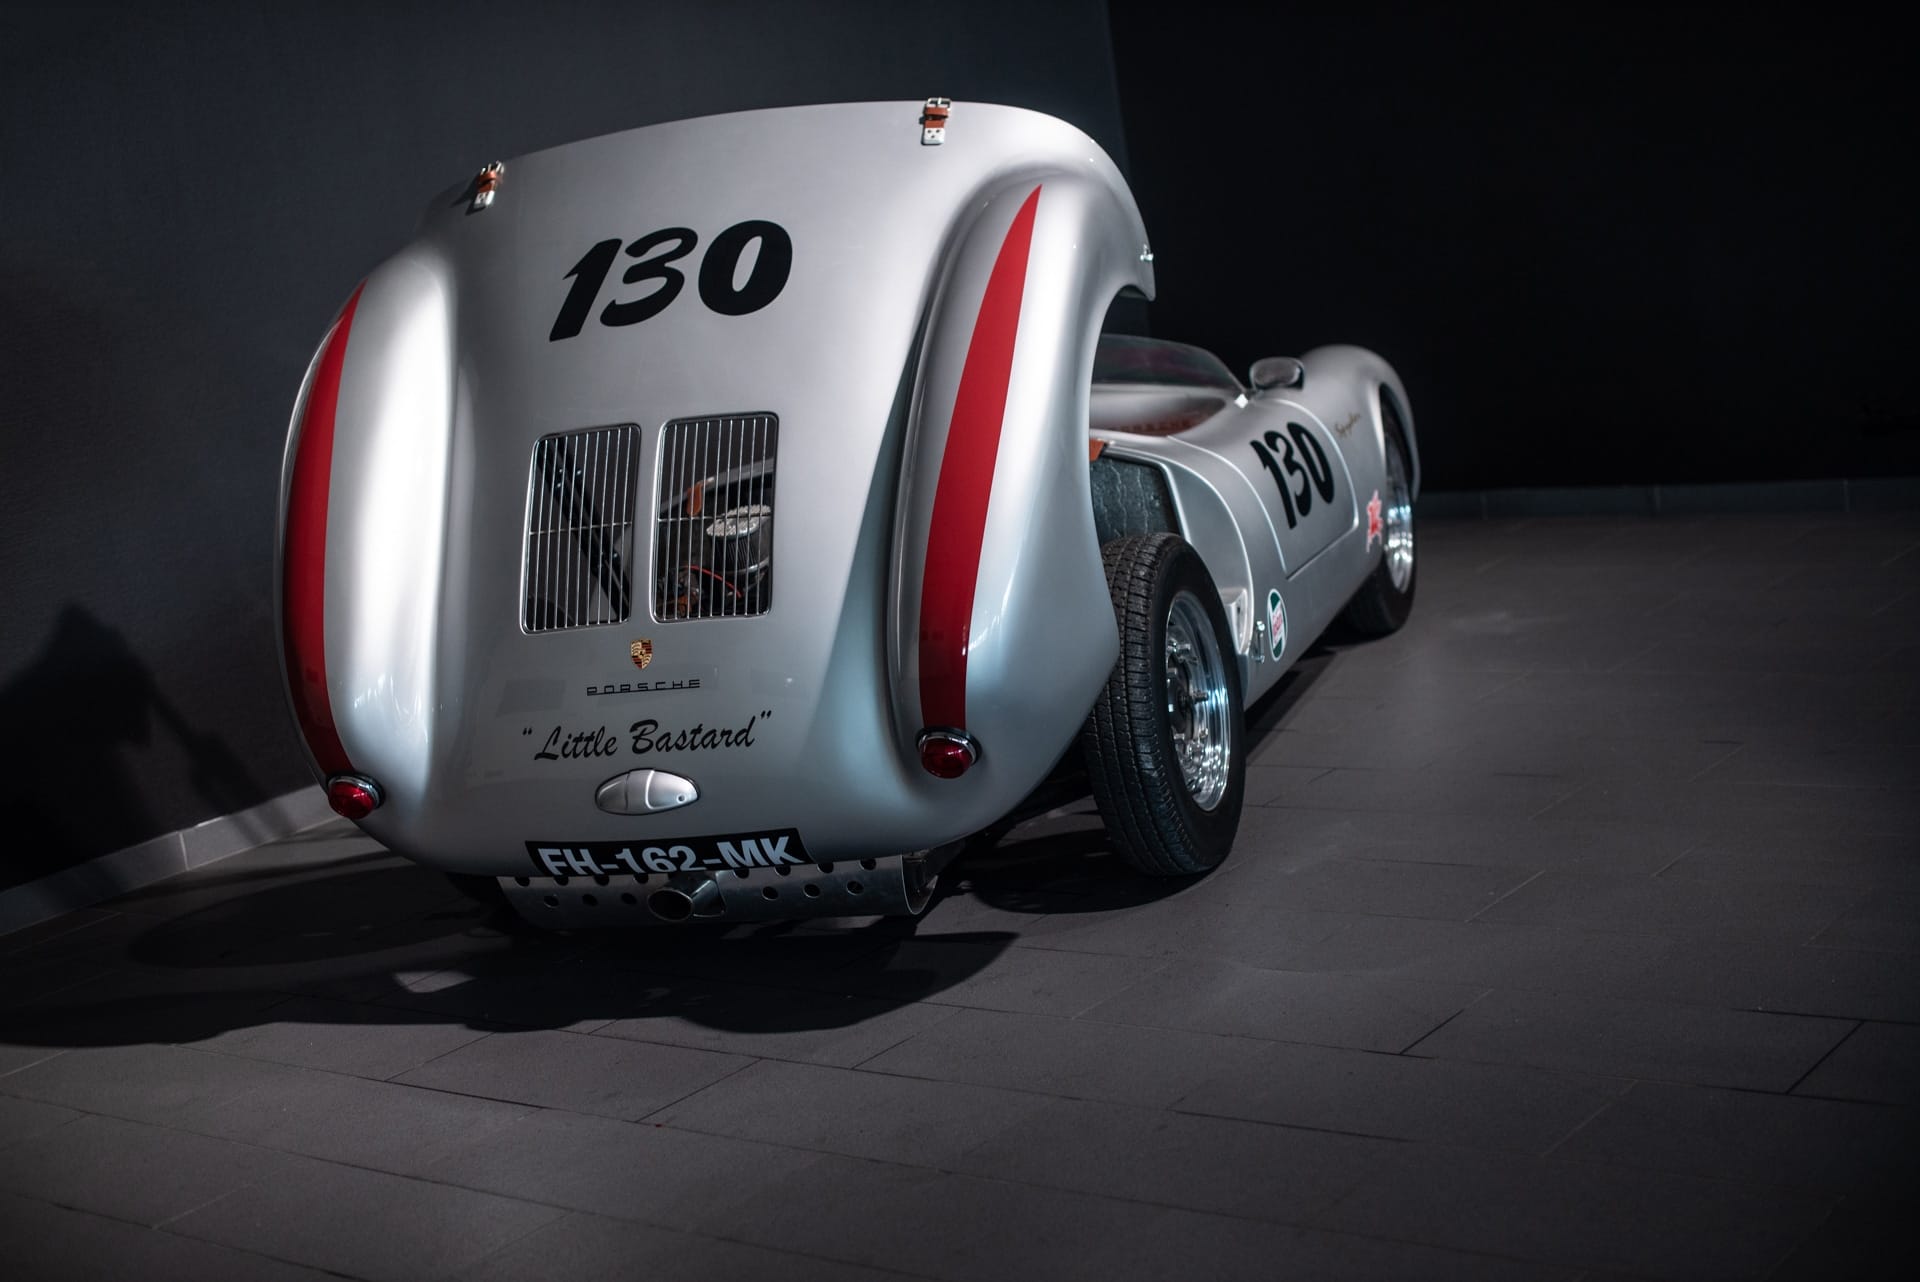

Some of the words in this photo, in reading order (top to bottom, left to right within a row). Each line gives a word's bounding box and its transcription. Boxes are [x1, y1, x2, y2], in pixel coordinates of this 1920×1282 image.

[549, 219, 793, 342] 130
[1250, 421, 1335, 530] 130
[586, 679, 700, 696] PORSCHE
[537, 835, 804, 876] FH-162-MK
